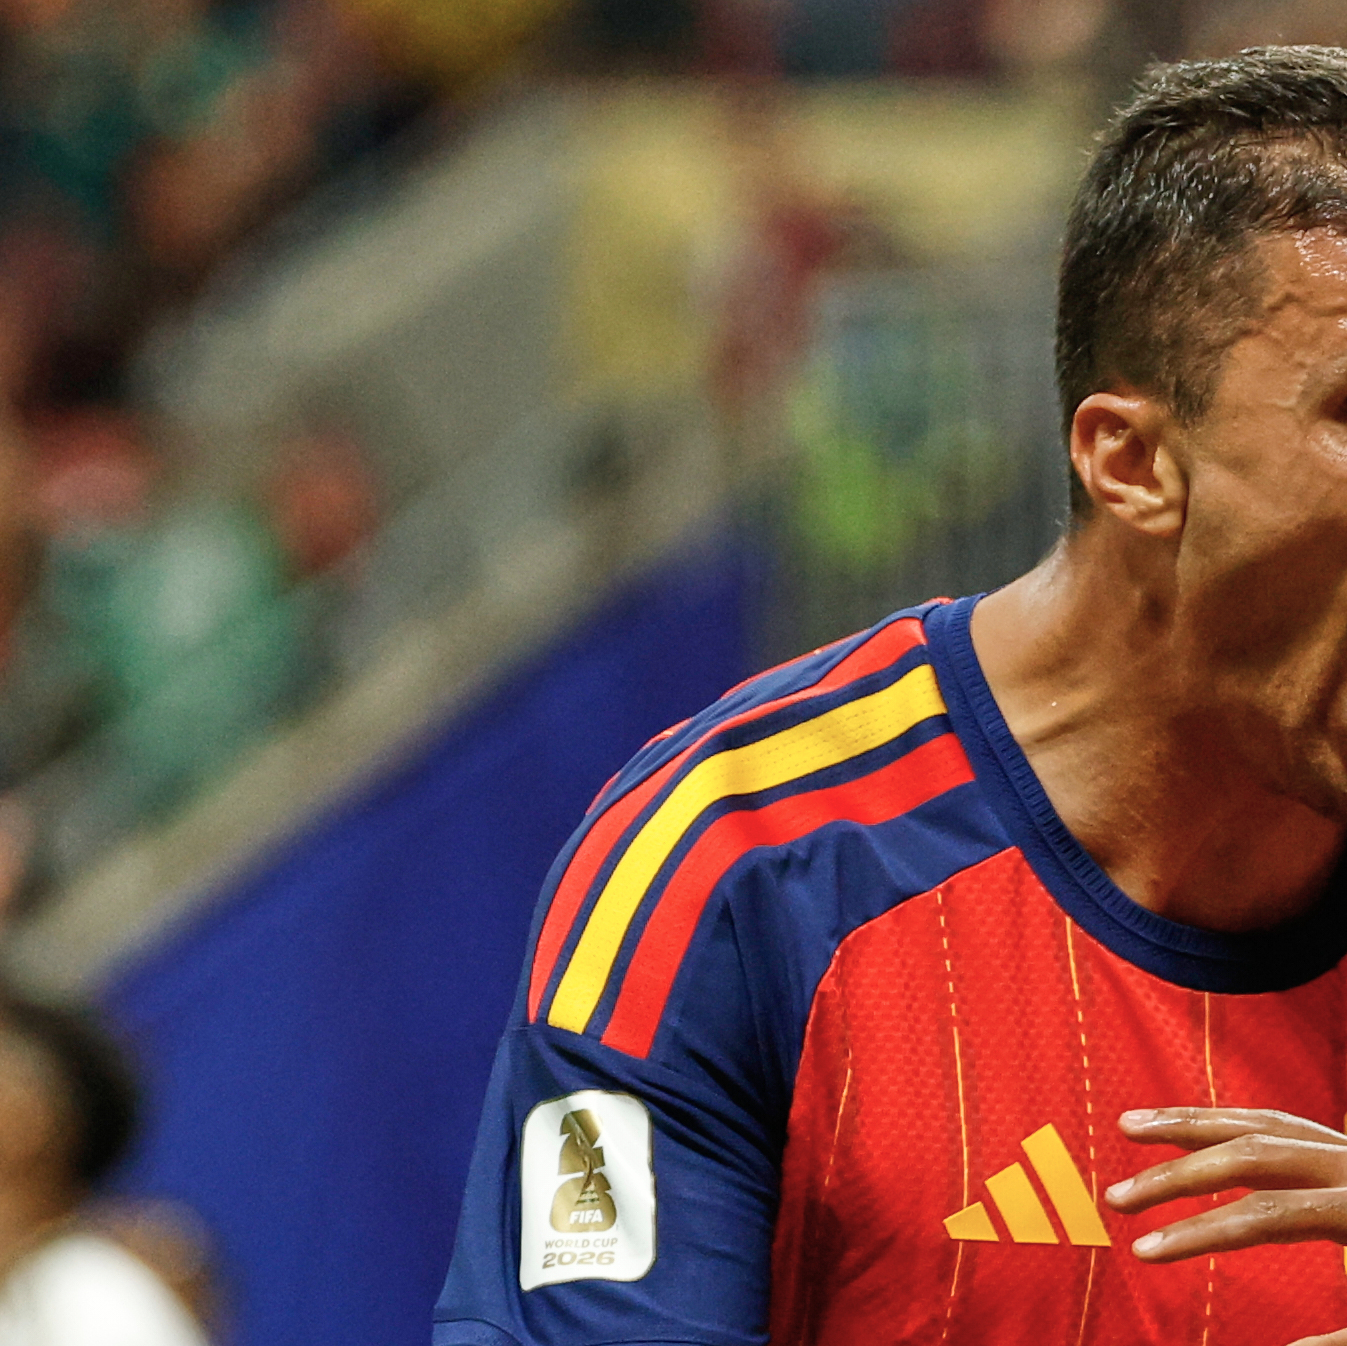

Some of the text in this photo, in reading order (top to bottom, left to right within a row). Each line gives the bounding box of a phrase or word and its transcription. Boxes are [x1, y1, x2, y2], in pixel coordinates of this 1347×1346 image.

[570, 1210, 603, 1224] FIFA
[544, 1237, 618, 1250] WORLD CUP
[542, 1251, 616, 1269] 2026
